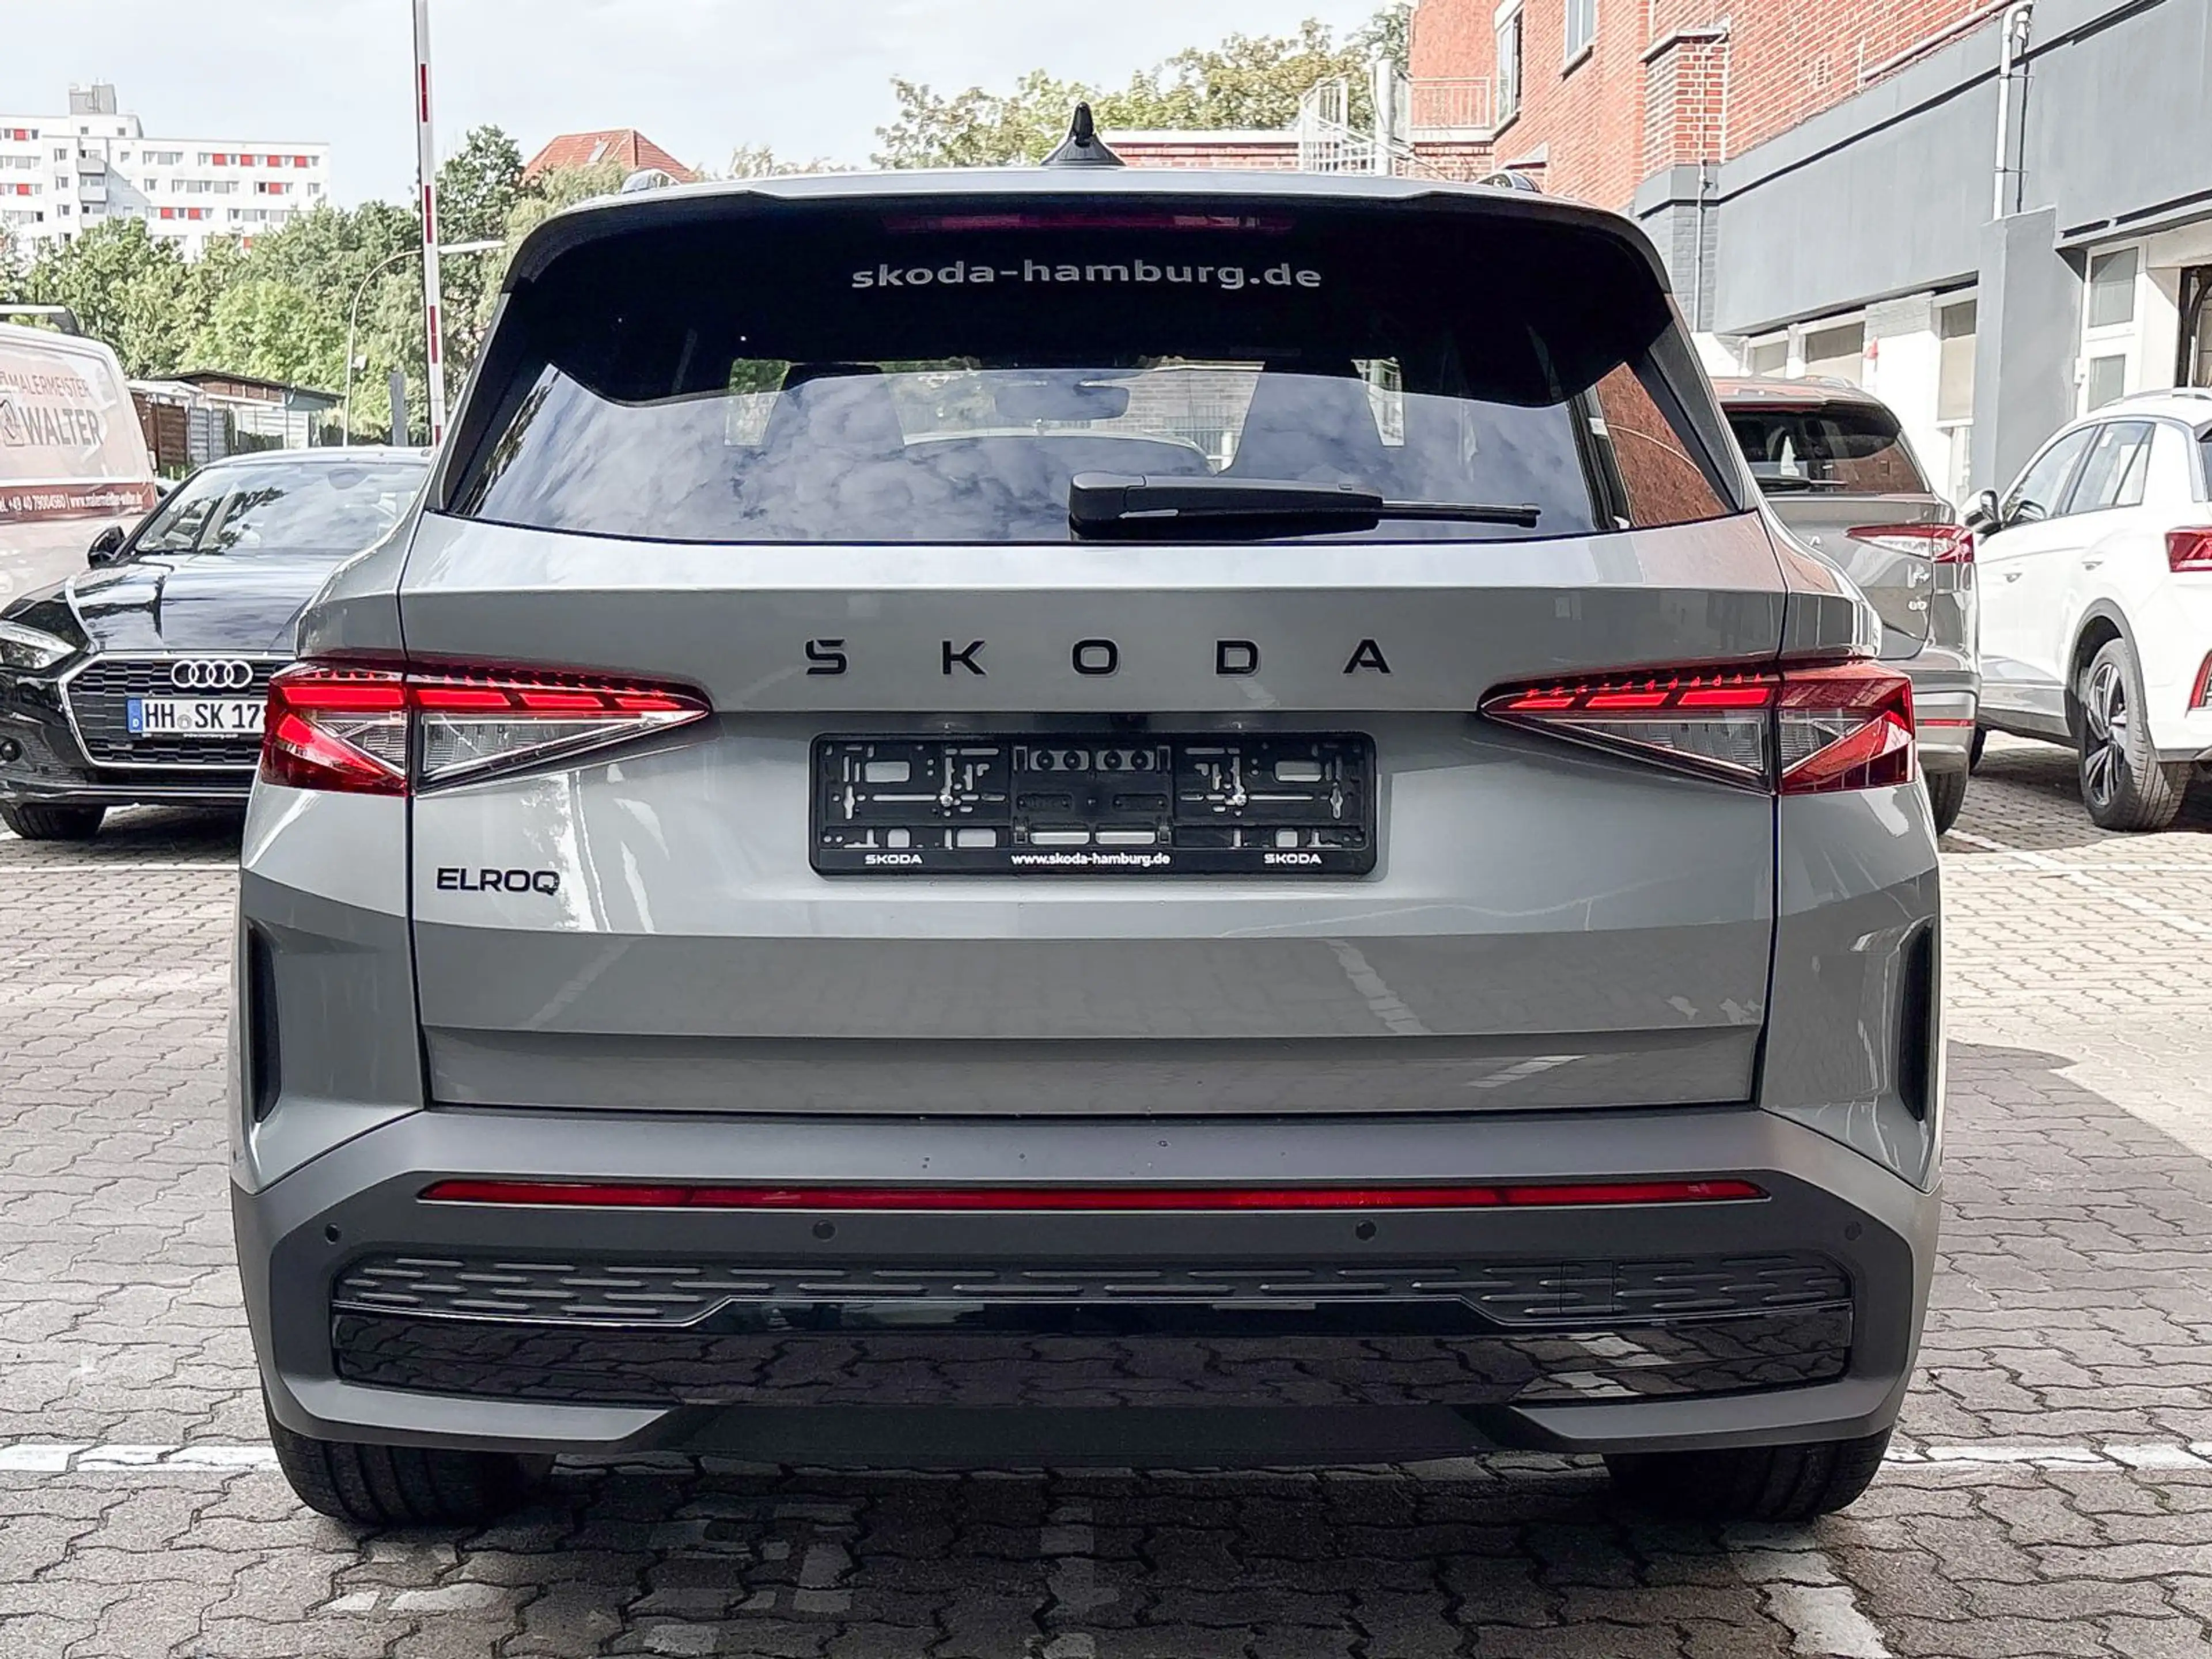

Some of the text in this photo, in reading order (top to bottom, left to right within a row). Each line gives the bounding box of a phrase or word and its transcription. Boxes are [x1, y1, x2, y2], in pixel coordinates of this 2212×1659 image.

[851, 259, 1321, 289] skoda-hamburg.de
[8, 373, 90, 397] MALERMEISTER
[18, 406, 104, 445] WALTER
[145, 703, 175, 728] HH
[195, 703, 224, 729] SK
[232, 704, 265, 728] 17
[865, 852, 1322, 868] SKODA www.skoda-hamburg.de SKODA
[437, 868, 560, 896] ELROQ
